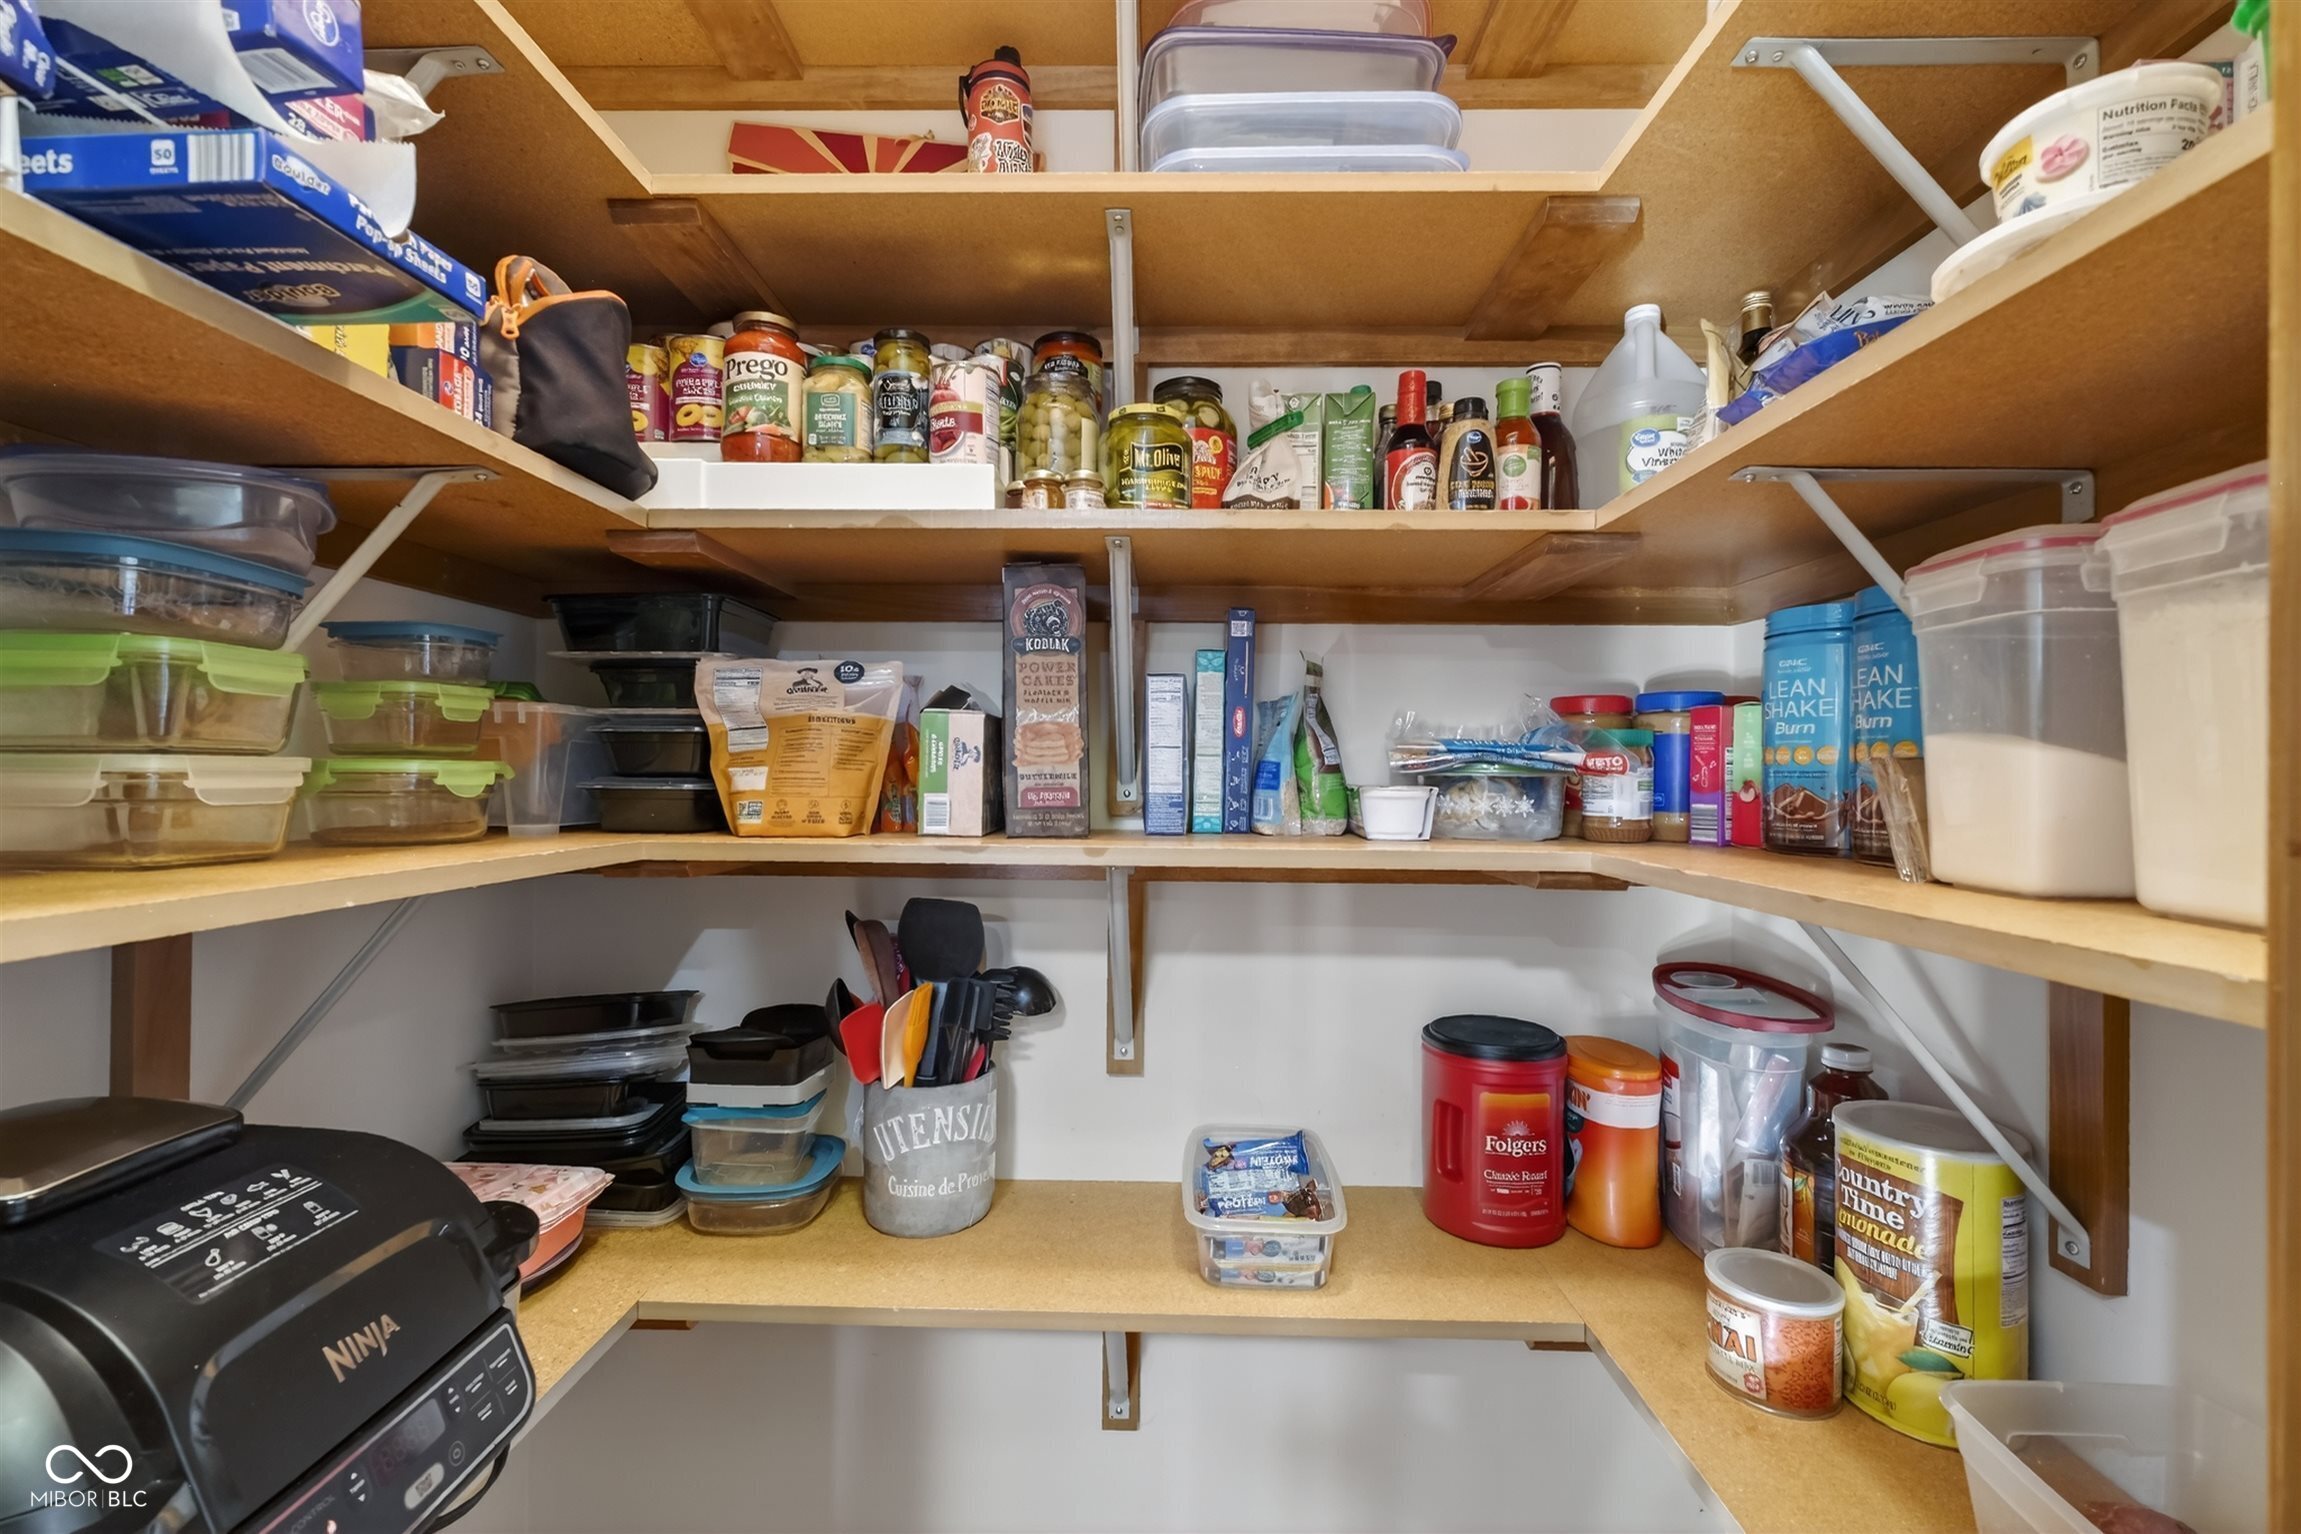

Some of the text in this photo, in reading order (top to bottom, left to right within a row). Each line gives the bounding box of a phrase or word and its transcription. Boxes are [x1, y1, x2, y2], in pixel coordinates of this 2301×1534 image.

[2102, 98, 2198, 121] Nutrition Facts
[154, 147, 173, 160] 50
[272, 155, 332, 196] Boulder
[259, 258, 394, 278] Parchment
[726, 358, 789, 380] Prego
[1153, 447, 1181, 468] Olive
[1025, 637, 1070, 652] KODIAK
[1018, 661, 1077, 674] POWER
[1852, 663, 1904, 689] EAN
[1022, 675, 1074, 687] CAKES
[1769, 677, 1827, 700] LEAN
[1764, 697, 1836, 720] SHAKE
[1774, 722, 1816, 736] Burn
[1855, 715, 1893, 730] Burn
[1484, 1135, 1548, 1158] Folgers
[1483, 1169, 1548, 1182] Classic Roast
[888, 1175, 936, 1198] Cuisine
[938, 1176, 957, 1196] de
[1217, 1196, 1266, 1210] PROTEIN
[1840, 1184, 1905, 1231] Time
[321, 1313, 401, 1383] NINJA
